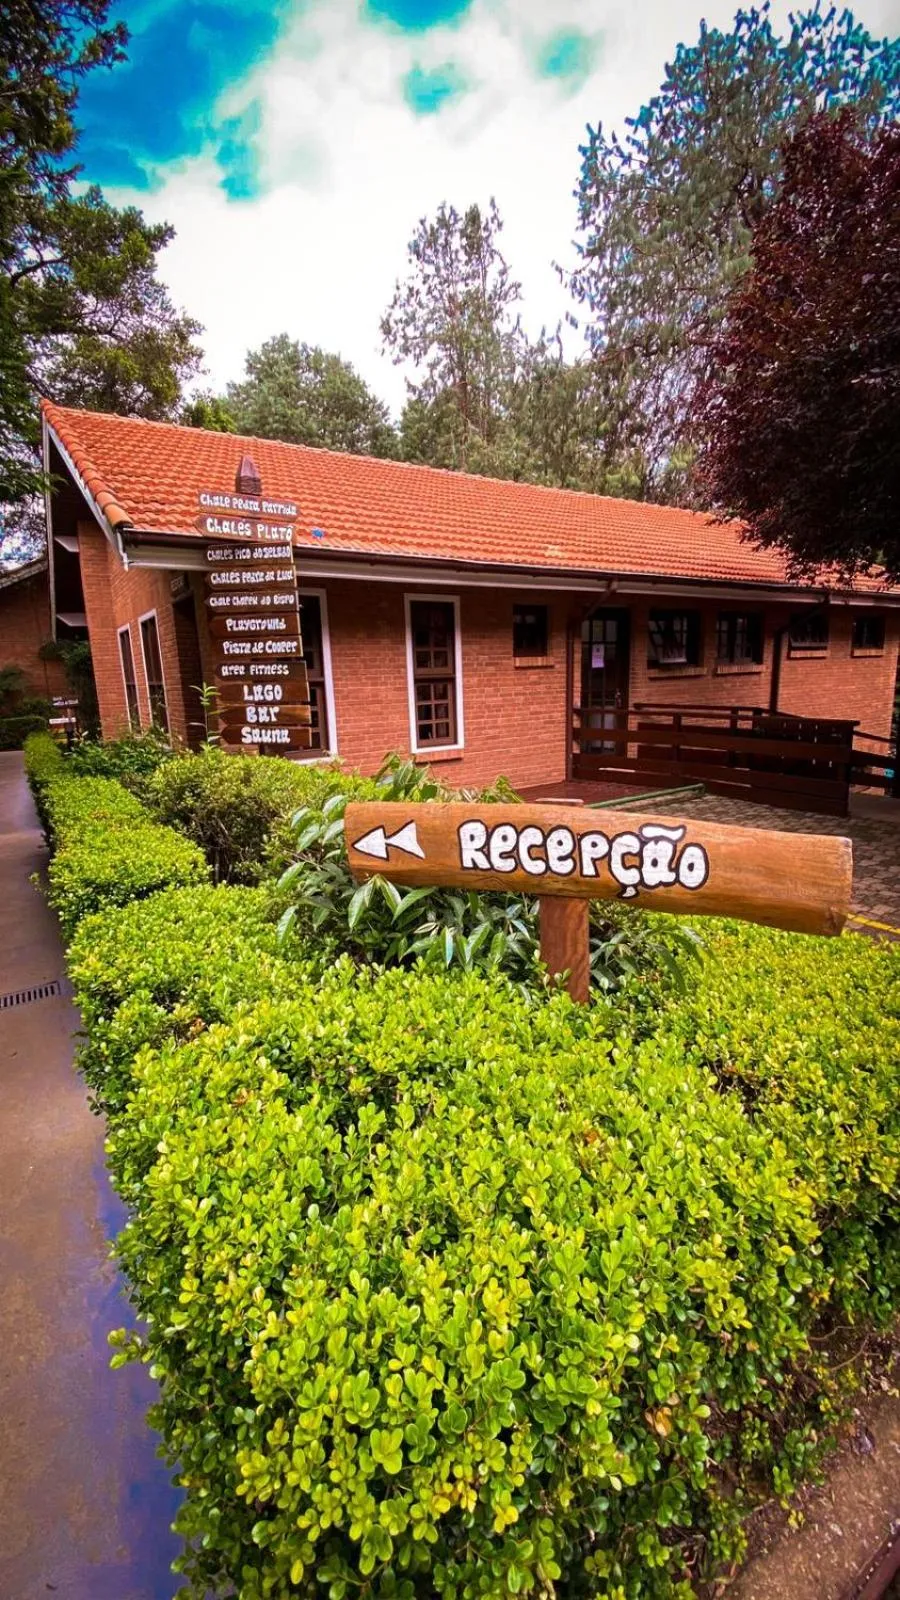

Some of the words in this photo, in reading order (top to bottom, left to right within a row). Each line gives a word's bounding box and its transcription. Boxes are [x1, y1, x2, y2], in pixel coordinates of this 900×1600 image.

[222, 640, 251, 655] Pista
[251, 640, 264, 653] de
[265, 640, 298, 653] Cooper
[240, 726, 291, 744] Sauna
[457, 820, 711, 900] Recepção
